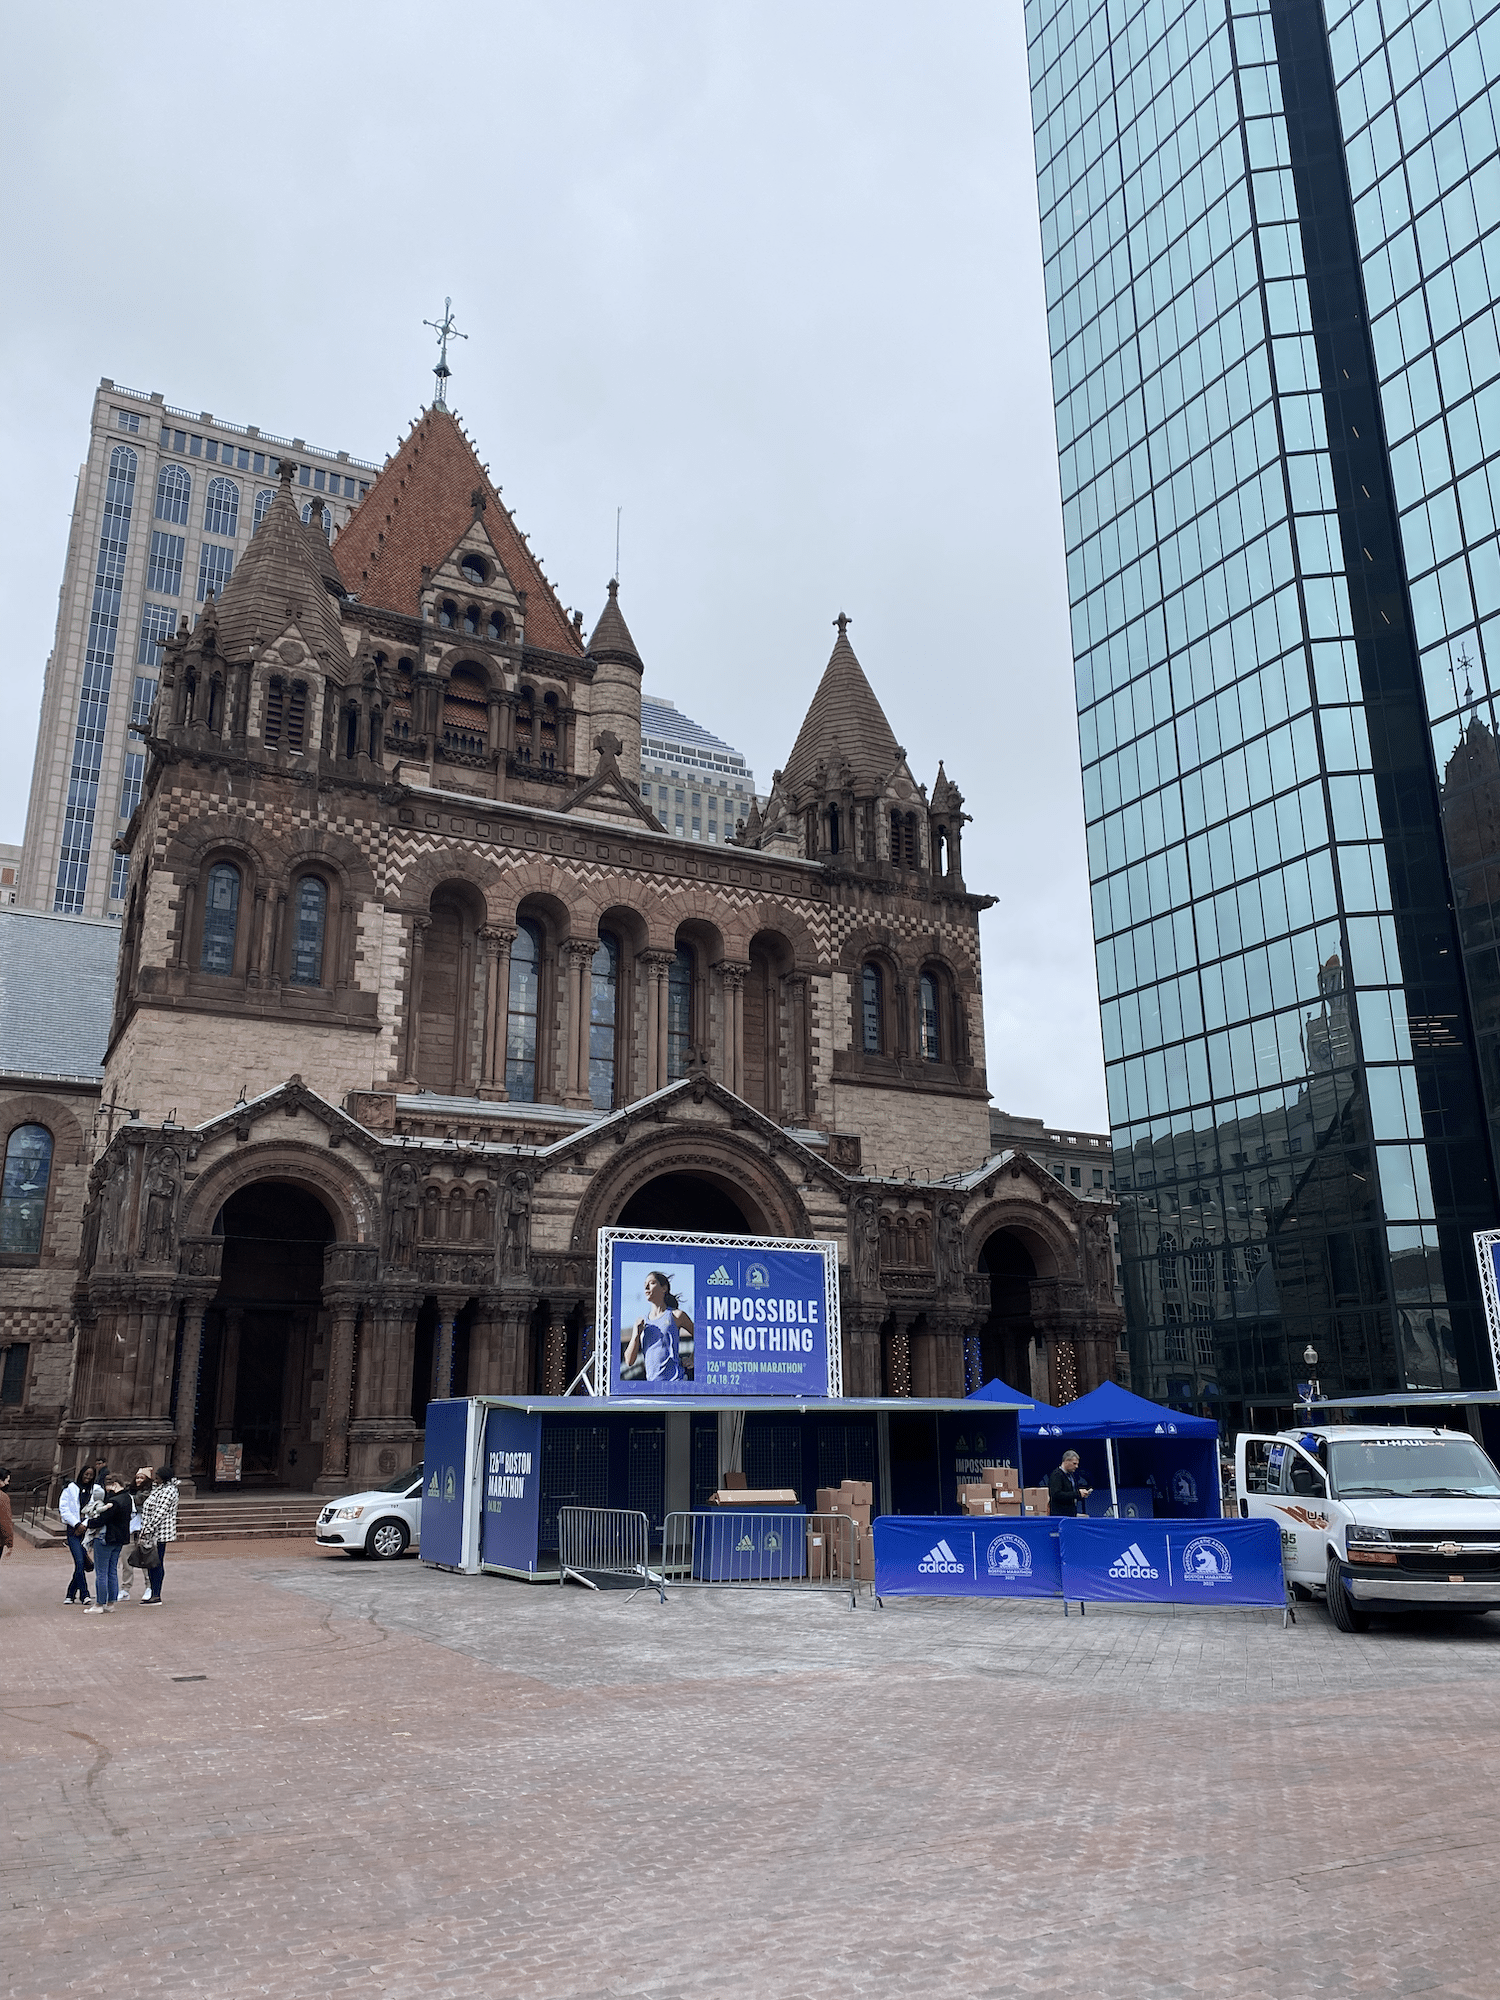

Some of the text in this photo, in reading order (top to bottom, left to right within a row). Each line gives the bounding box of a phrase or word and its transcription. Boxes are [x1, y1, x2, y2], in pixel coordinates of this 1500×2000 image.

[707, 1277, 734, 1286] adidas
[706, 1296, 818, 1323] IMPOSSIBLE
[706, 1325, 814, 1352] IS NOTHING
[727, 1361, 759, 1373] BOSTON
[760, 1362, 803, 1374] MARATHON
[706, 1374, 740, 1385] 04.18.22
[505, 1452, 532, 1475] BOSTON
[487, 1475, 525, 1499] MARATHON
[917, 1561, 965, 1574] adidas
[1108, 1565, 1159, 1579] adidas
